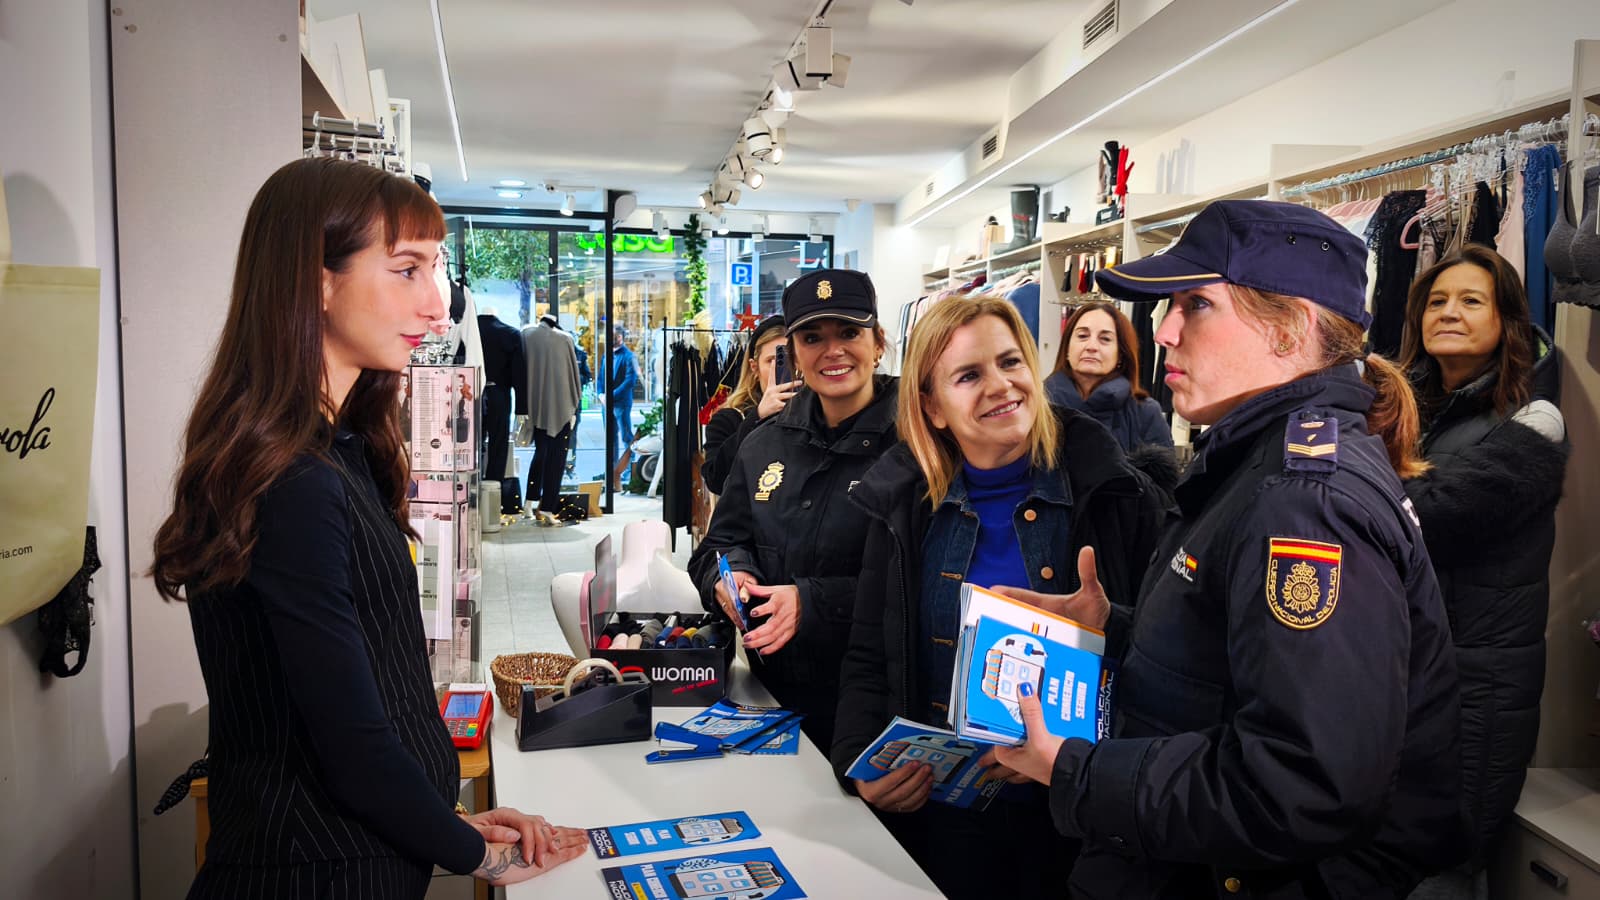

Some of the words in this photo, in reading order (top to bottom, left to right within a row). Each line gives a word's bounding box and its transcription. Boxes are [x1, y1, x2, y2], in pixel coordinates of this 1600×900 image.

[1269, 559, 1279, 602] CUERPO
[1326, 566, 1338, 606] POLICIA
[1272, 601, 1316, 624] NACIONAL
[651, 666, 715, 681] WOMAN
[1047, 676, 1060, 706] PLAN
